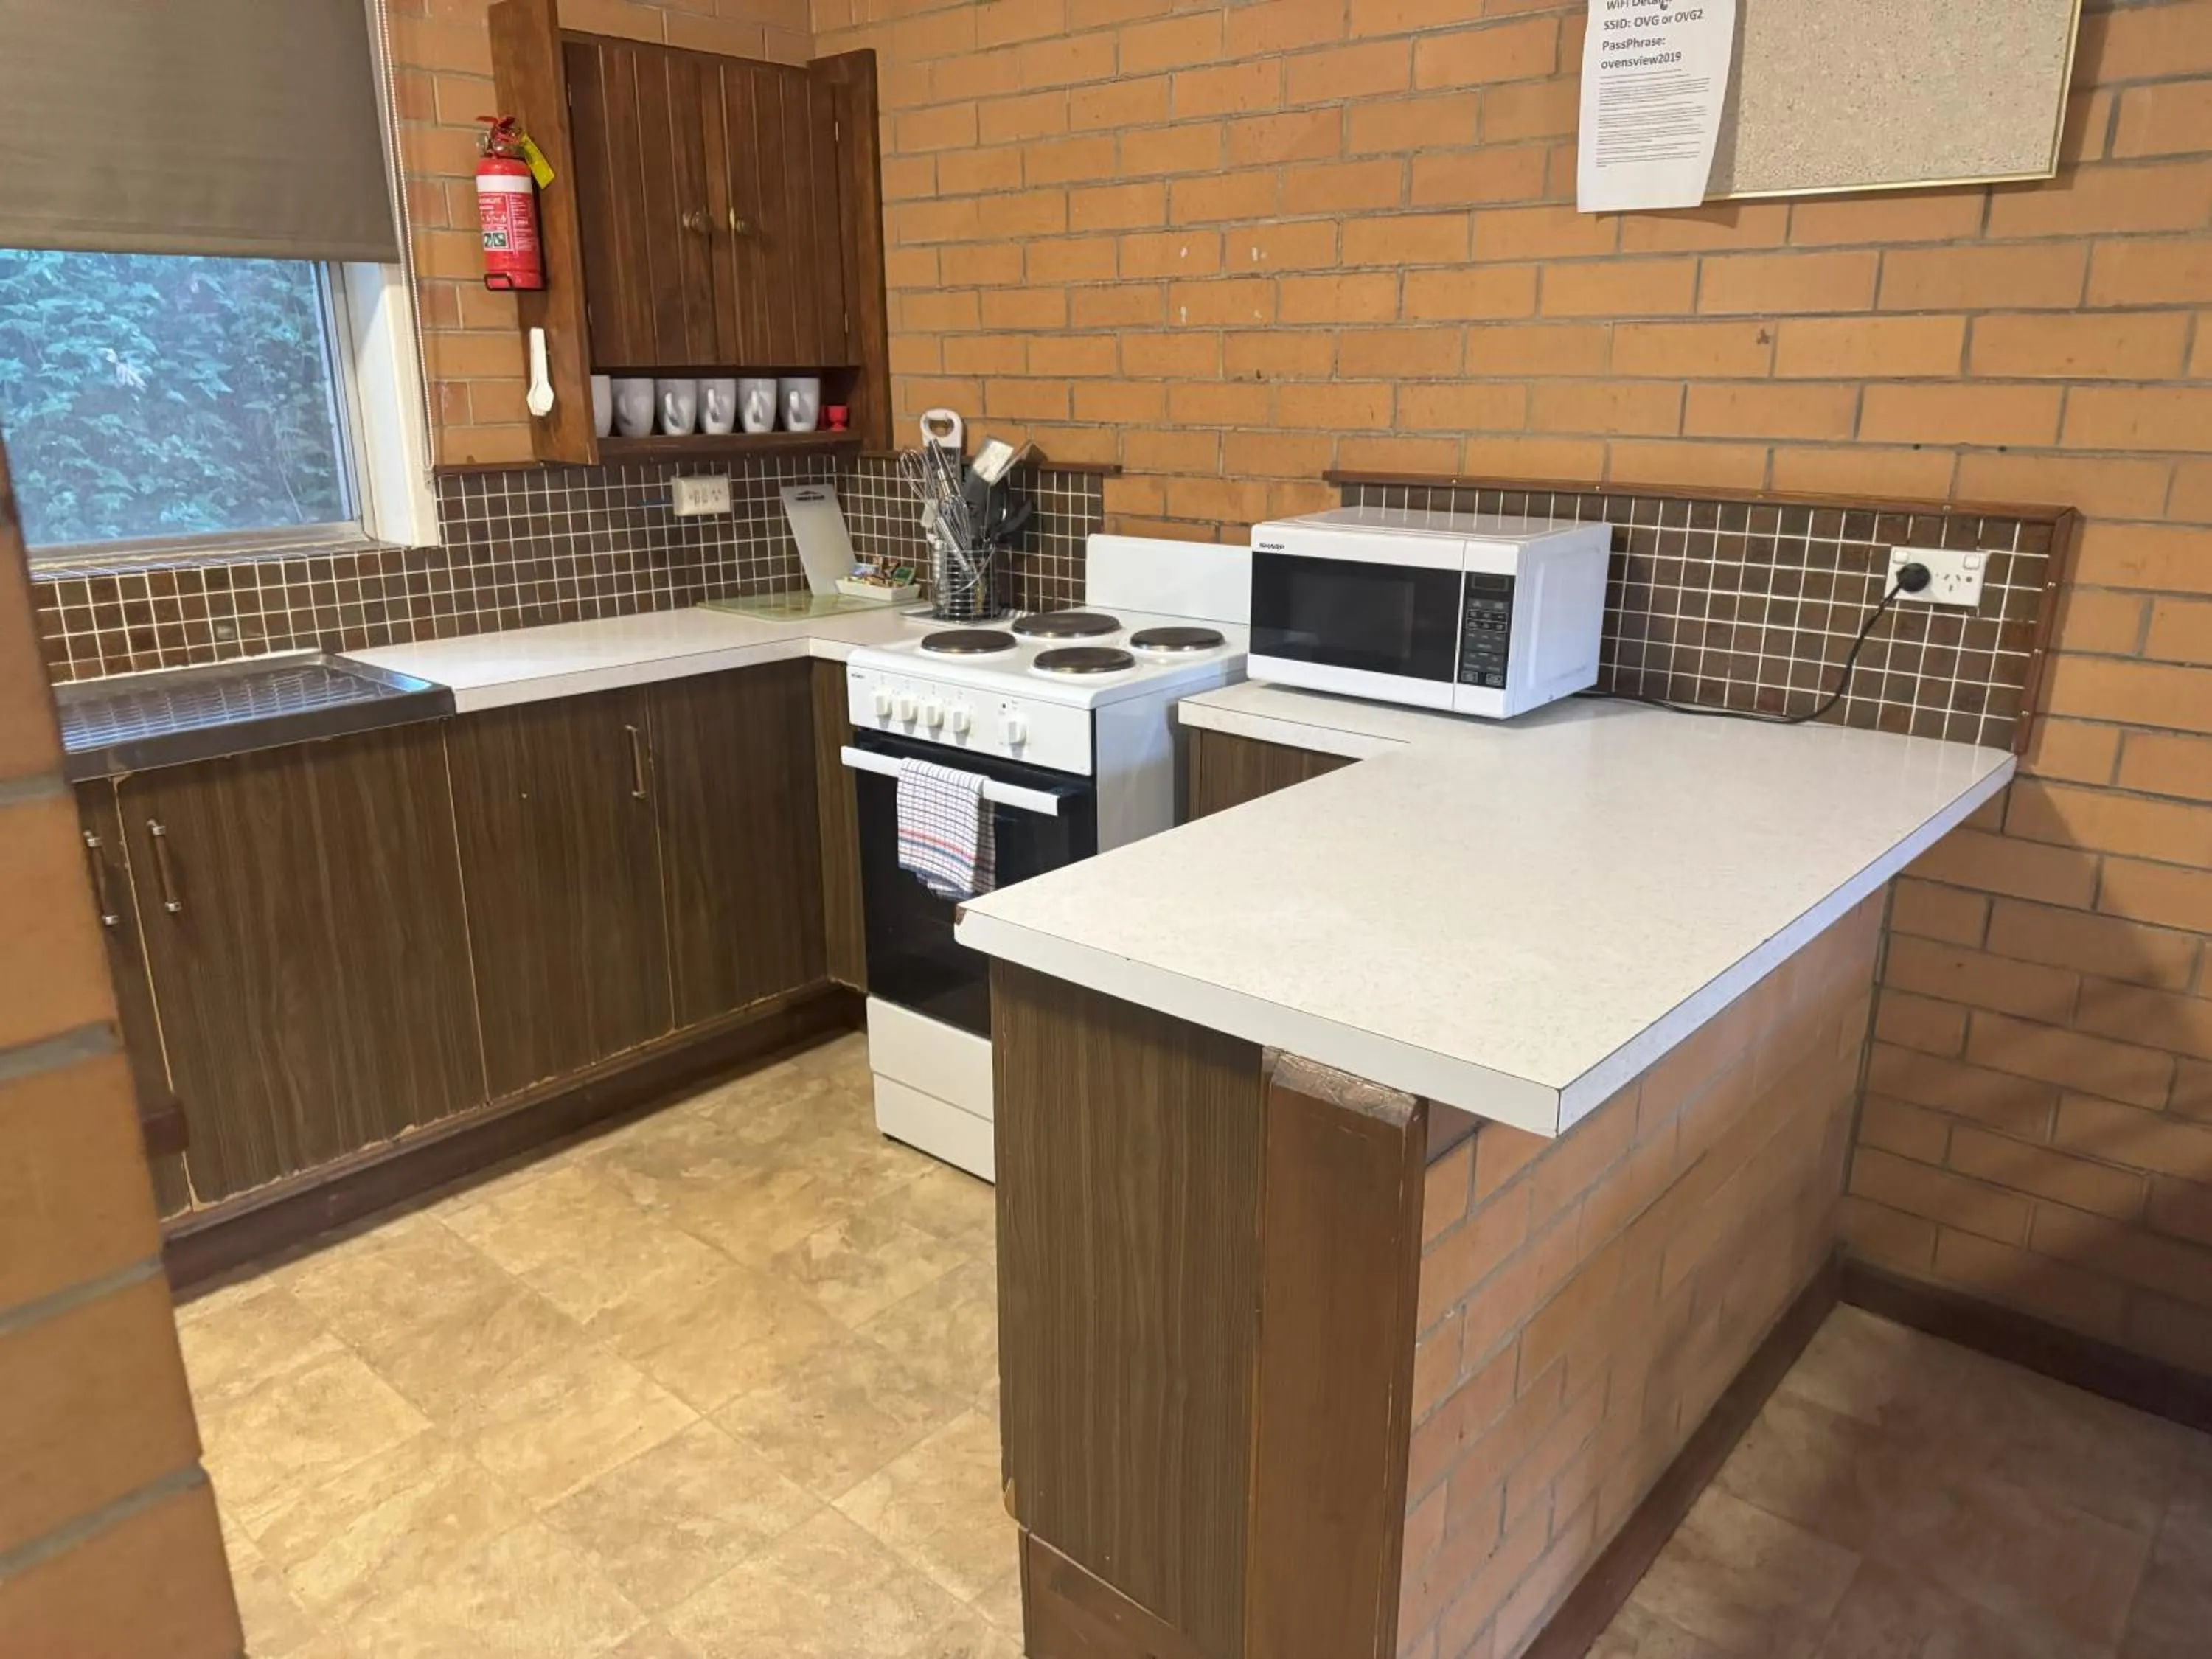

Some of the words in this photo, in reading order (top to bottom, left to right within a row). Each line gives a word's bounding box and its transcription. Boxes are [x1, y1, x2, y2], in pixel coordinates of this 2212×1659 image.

[1604, 18, 1631, 30] SSID:
[1634, 15, 1659, 27] OVG
[1661, 15, 1673, 24] or
[1674, 9, 1703, 23] OVG2
[1602, 37, 1666, 51] PassPhrase:
[1601, 52, 1682, 69] ovensview2019
